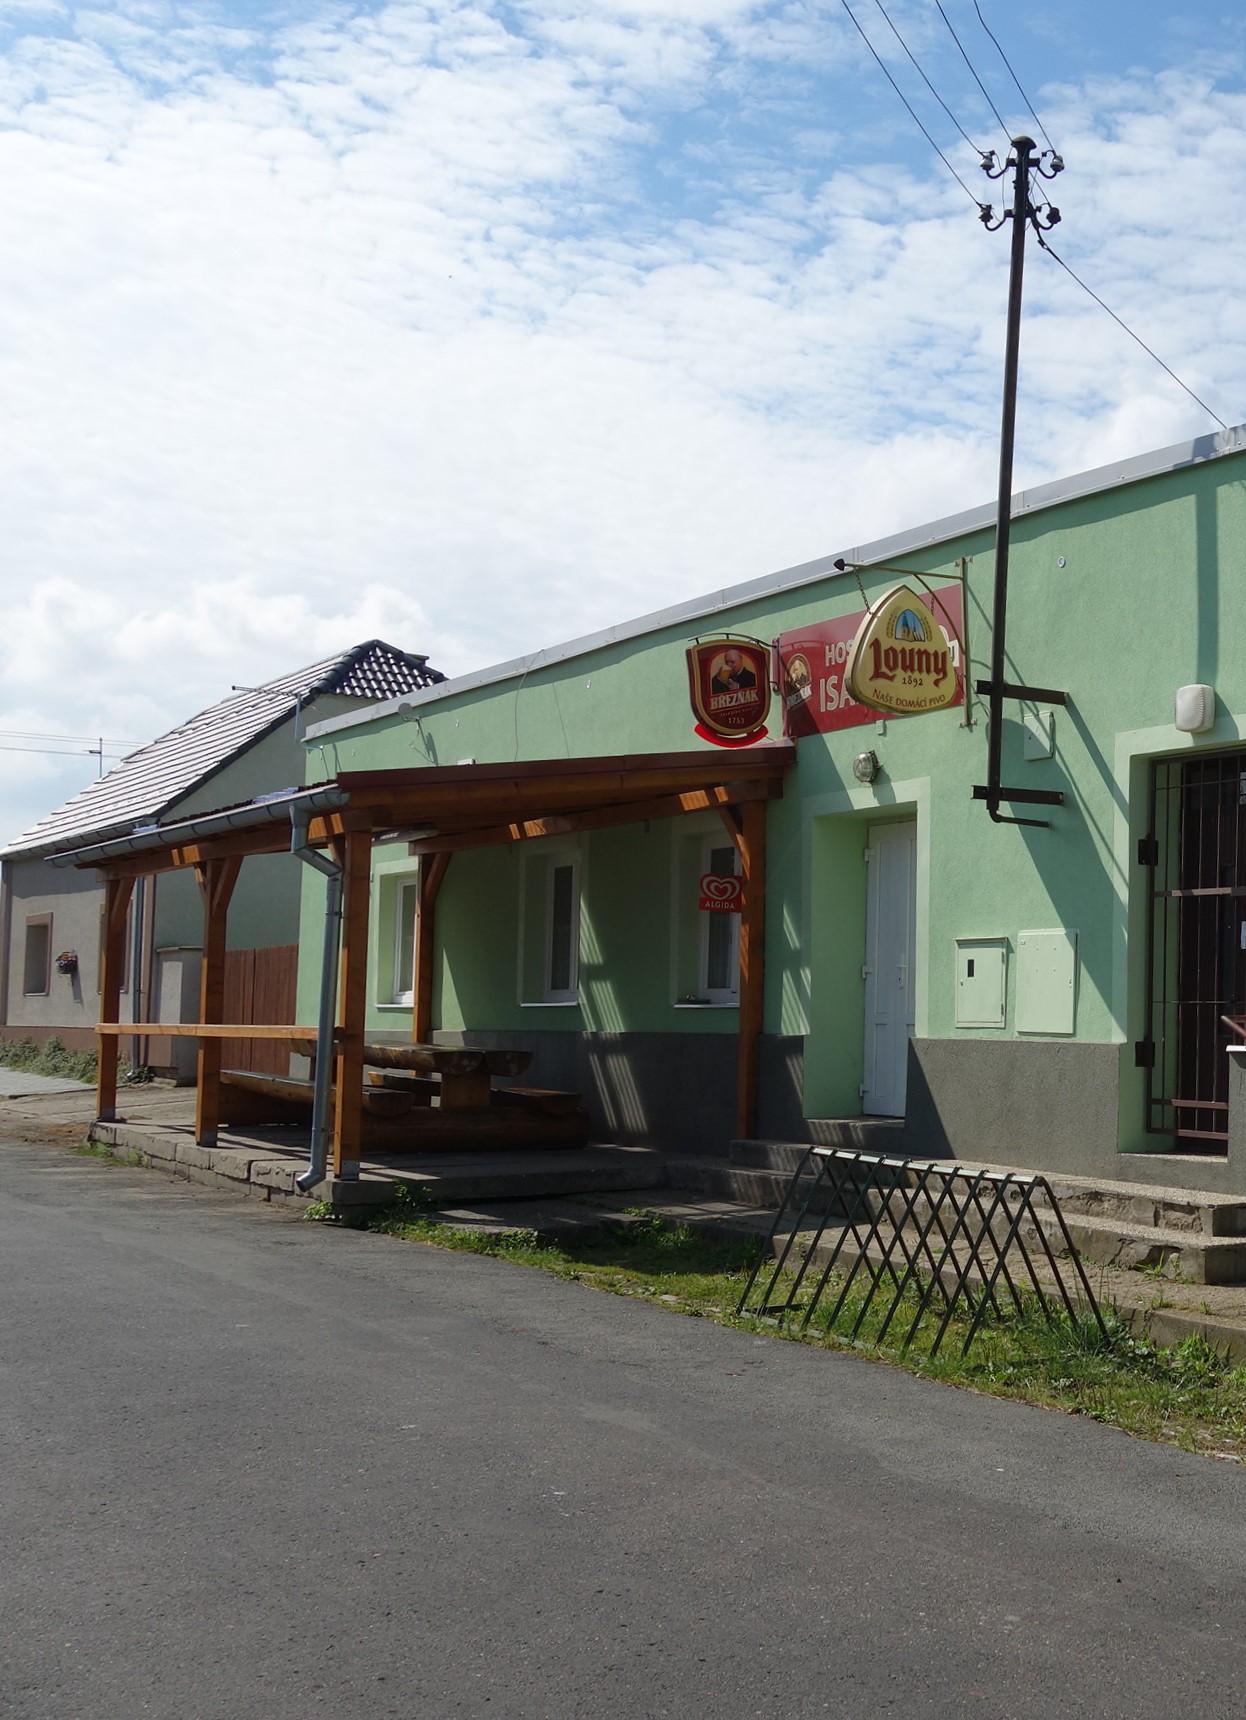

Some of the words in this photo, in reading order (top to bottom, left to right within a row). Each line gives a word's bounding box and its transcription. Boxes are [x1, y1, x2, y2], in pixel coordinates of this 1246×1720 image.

[869, 637, 948, 688] Louny
[902, 675, 923, 688] 1892
[819, 675, 859, 712] ISA
[896, 696, 927, 708] DOMÁCÍ
[929, 694, 946, 706] PIVO
[727, 716, 745, 725] 1753
[704, 901, 735, 909] ALGIDA
